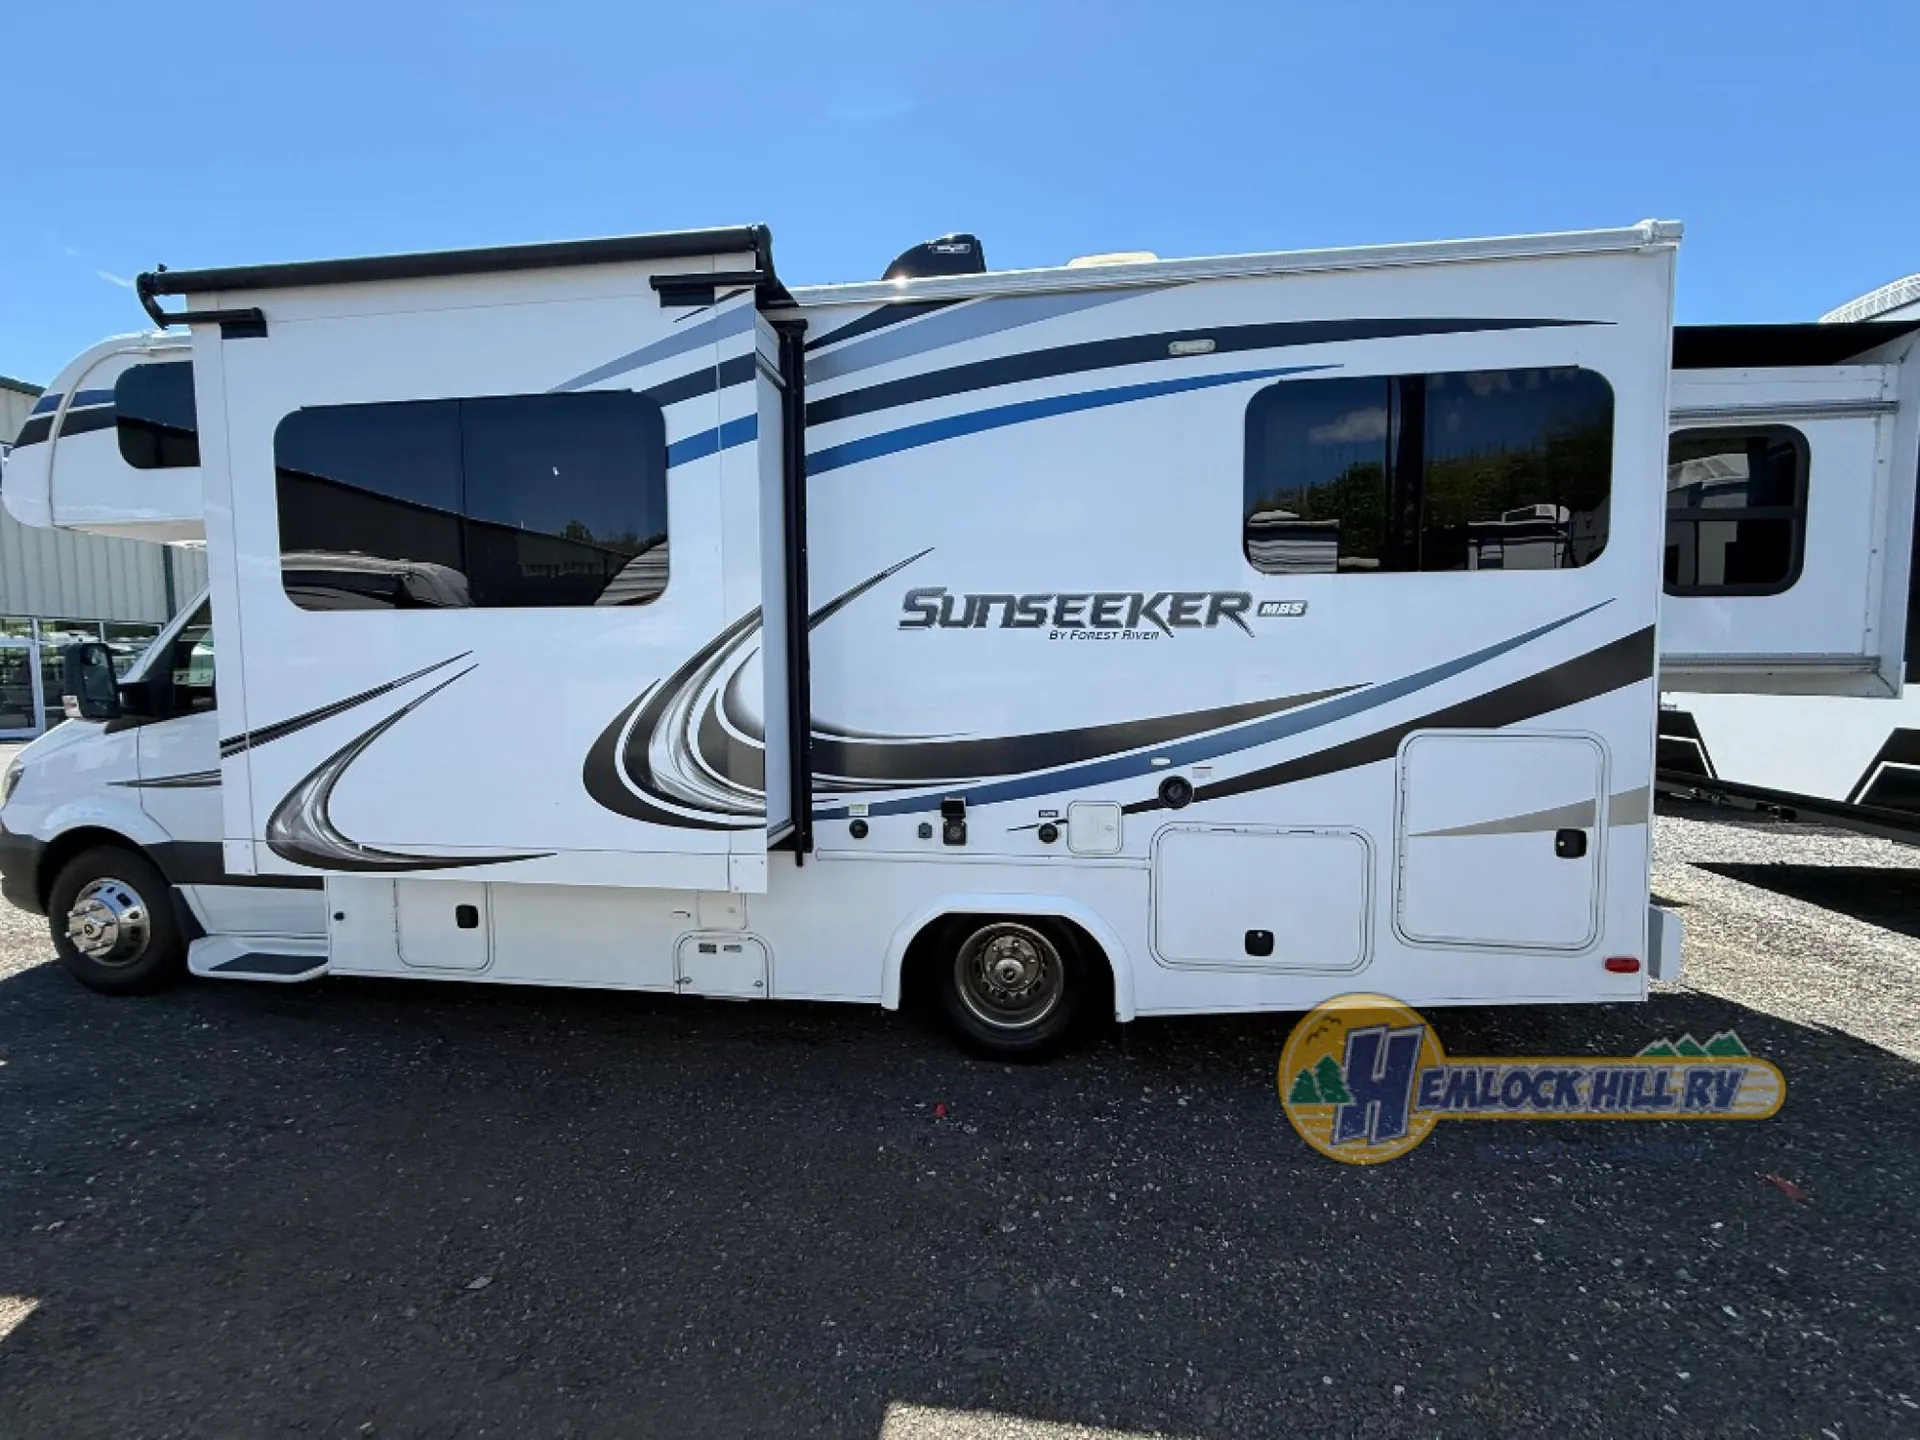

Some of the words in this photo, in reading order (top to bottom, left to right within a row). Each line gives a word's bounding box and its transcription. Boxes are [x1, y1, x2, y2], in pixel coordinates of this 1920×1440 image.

[898, 586, 1255, 638] SUNSEEKER
[1260, 602, 1304, 615] MBS
[1070, 629, 1119, 640] FOREST
[1121, 629, 1160, 640] RIVER
